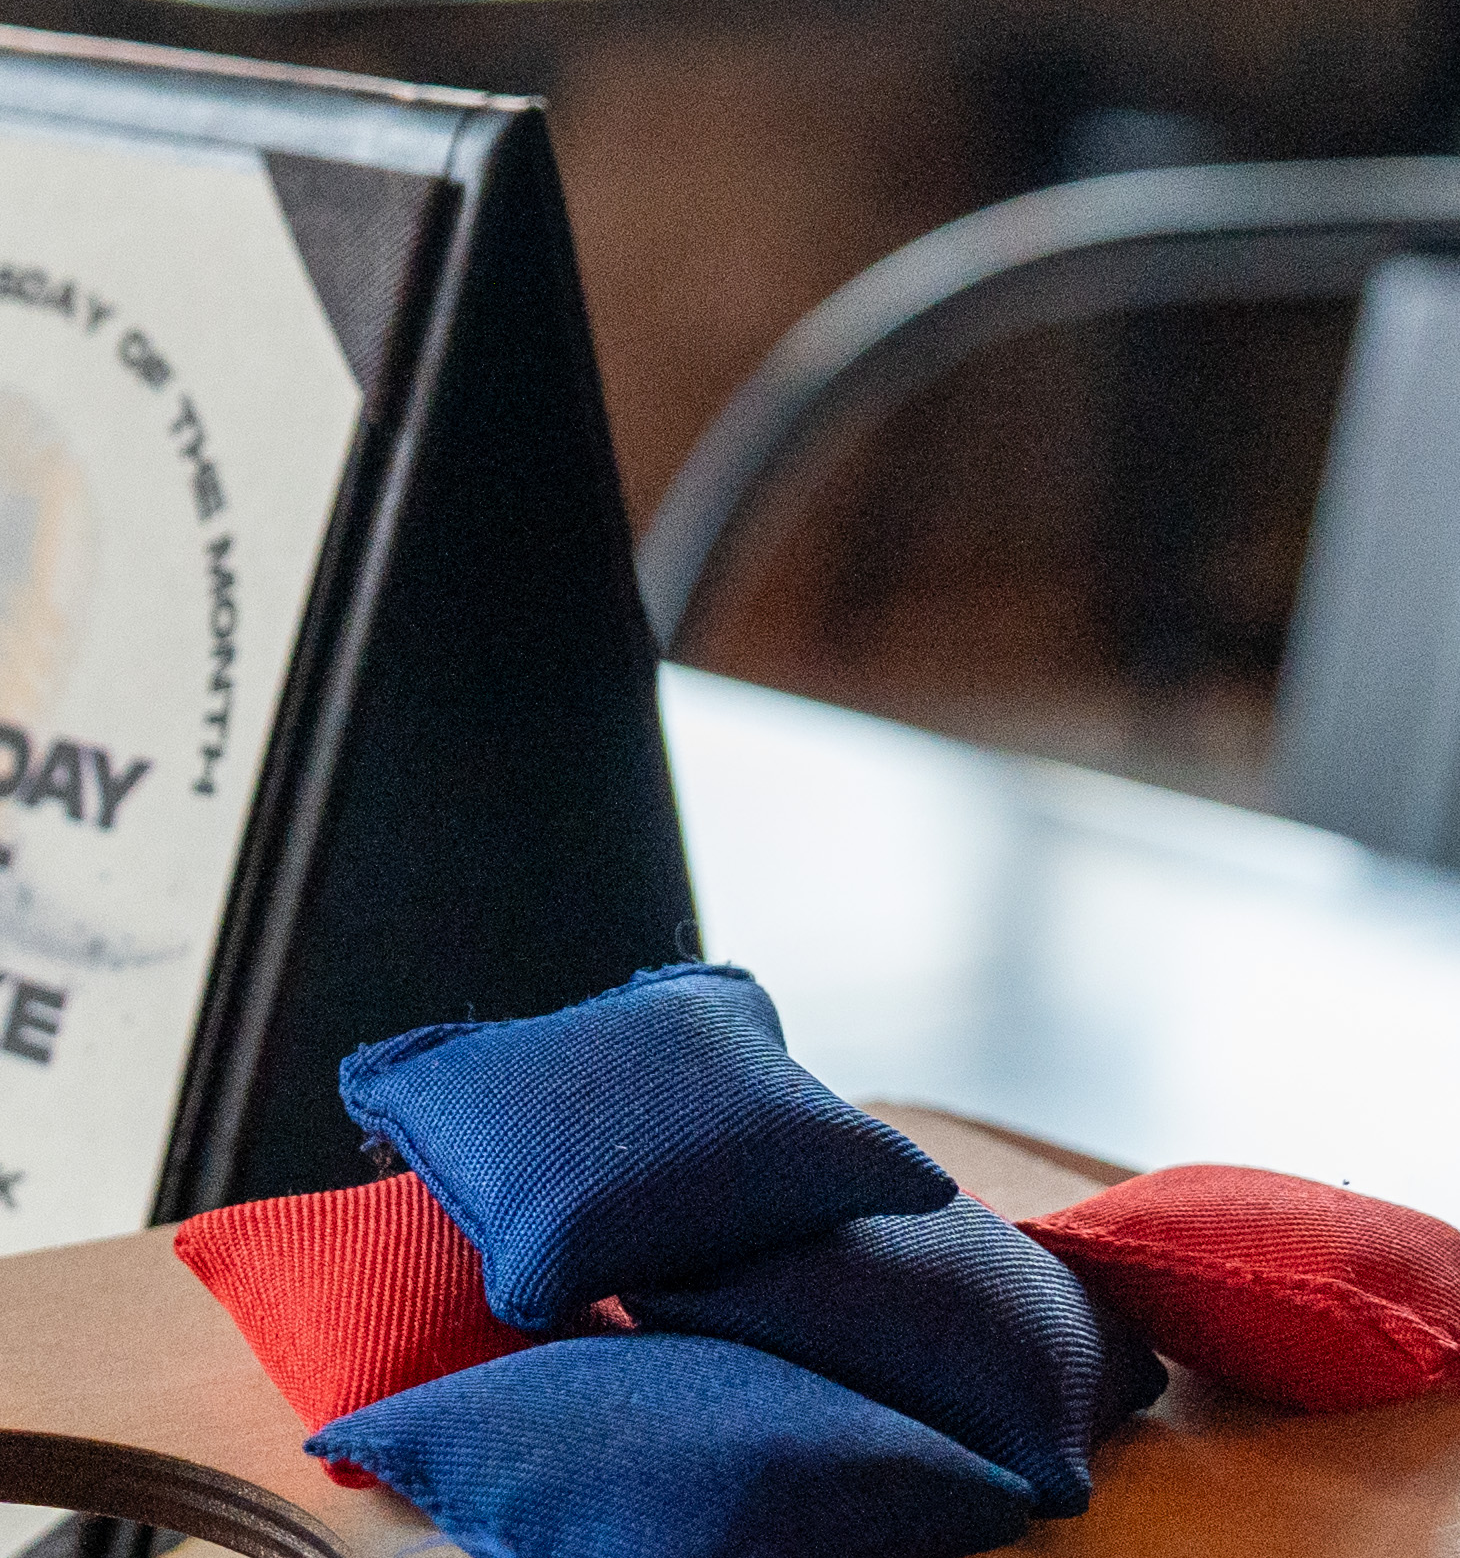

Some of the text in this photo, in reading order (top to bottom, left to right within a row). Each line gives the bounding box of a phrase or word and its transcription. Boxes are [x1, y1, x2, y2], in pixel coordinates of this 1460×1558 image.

[117, 327, 175, 391] OF
[169, 392, 226, 522] THE
[193, 533, 238, 796] MONTH
